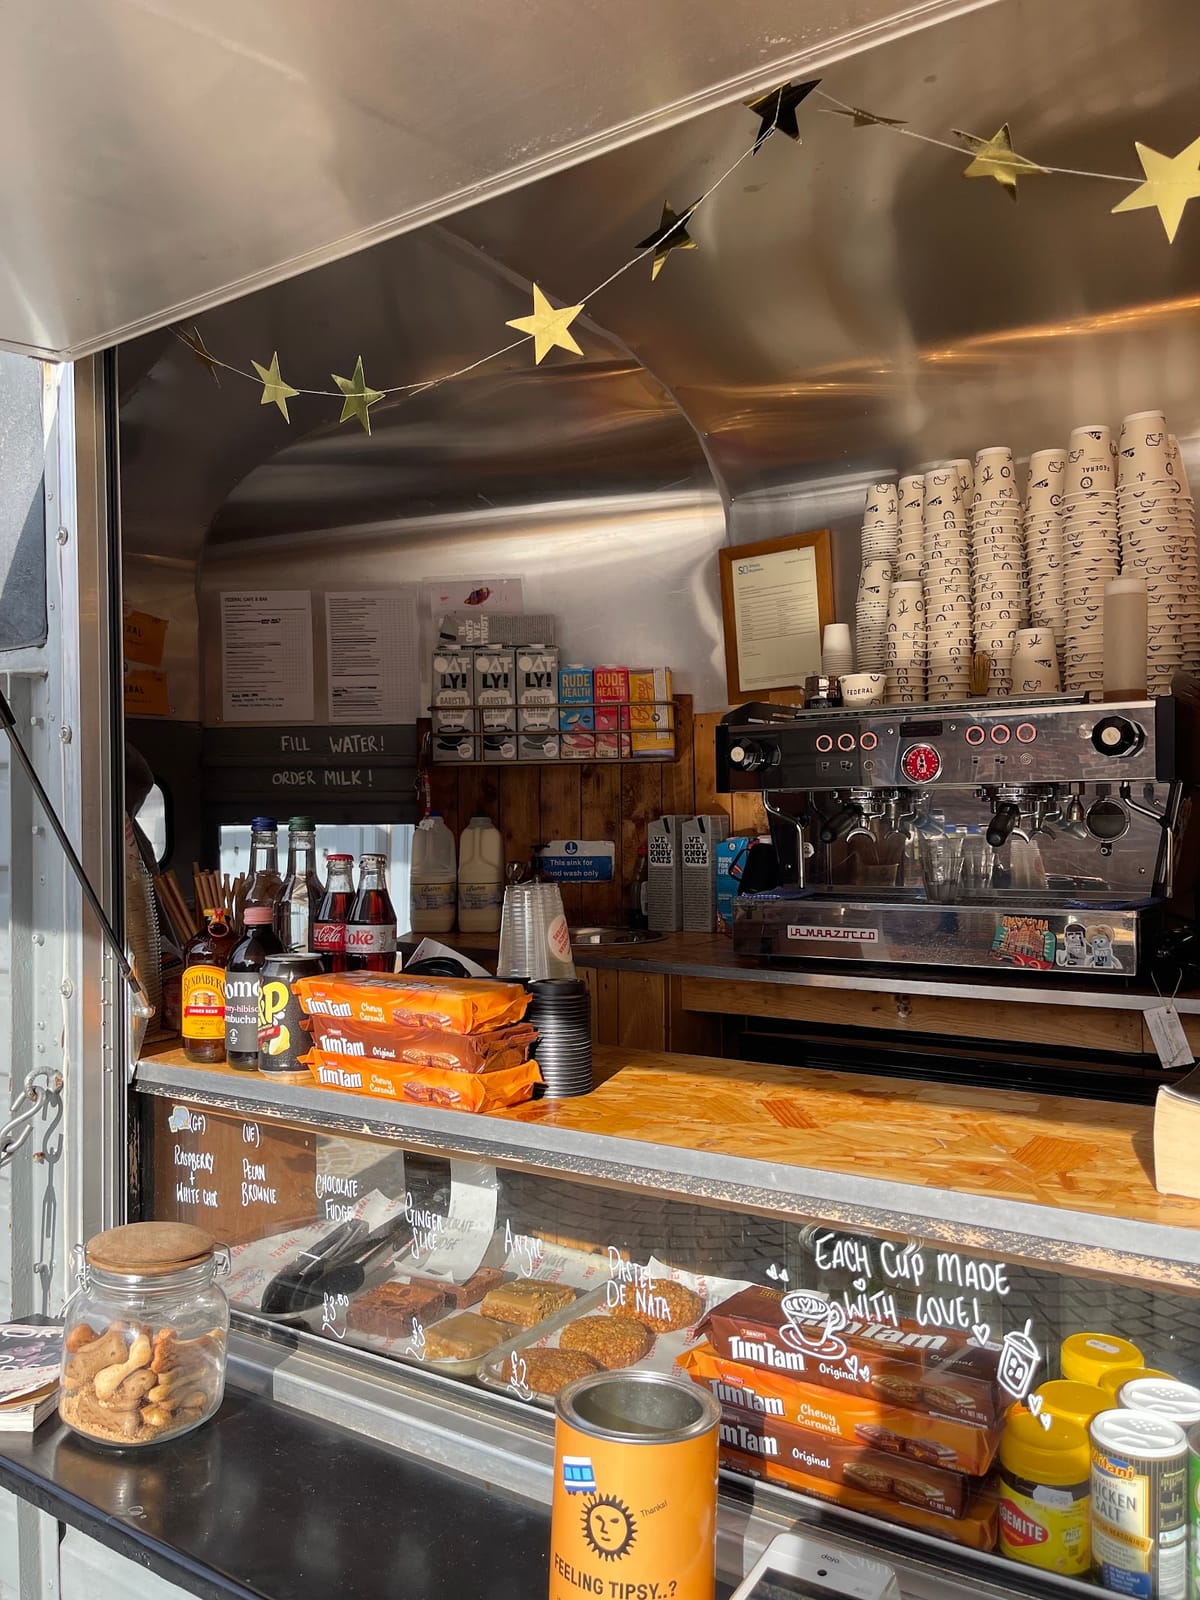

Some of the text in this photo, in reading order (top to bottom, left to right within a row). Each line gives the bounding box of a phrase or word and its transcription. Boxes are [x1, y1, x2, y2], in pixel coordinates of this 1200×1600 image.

[1081, 463, 1110, 474] FEDERAL
[458, 626, 466, 636] IN
[465, 620, 473, 643] OATS
[473, 622, 481, 640] WE
[480, 614, 489, 645] TRUST
[440, 673, 467, 689] LY!
[482, 673, 509, 689] LY!
[525, 672, 552, 688] LY!
[562, 674, 591, 687] RUDE
[596, 672, 626, 687] RUDE
[561, 687, 591, 697] HEALTH
[596, 687, 627, 697] HEALTH
[846, 687, 874, 697] FEDERAL
[280, 734, 385, 753] FILL WATER!
[272, 769, 317, 786] ORDER
[550, 859, 593, 867] This sink for
[583, 870, 599, 879] only
[359, 1012, 387, 1023] Caramel
[361, 1002, 383, 1016] Chewy
[372, 1046, 396, 1059] Original
[369, 1083, 396, 1096] Caramel
[371, 1074, 394, 1089] Chewy
[190, 1113, 206, 1135] (GF)
[243, 1123, 260, 1148] (VE)
[174, 1145, 214, 1174] RASPBERRY
[243, 1158, 266, 1181] PECAN
[176, 1182, 200, 1204] WHITE
[241, 1182, 277, 1207] BROWNIE
[315, 1174, 358, 1199] CHOCOLATE
[325, 1199, 354, 1222] FUDGE
[405, 1191, 445, 1234] GINGER
[411, 1227, 438, 1260] SLICE
[815, 1232, 872, 1279] EACH
[607, 1246, 658, 1291] PASTEL
[606, 1280, 673, 1323] DE NATA
[844, 1289, 980, 1327] WITH LOVE!
[728, 1336, 860, 1381] TimTam Original
[797, 1414, 842, 1435] Caramel
[800, 1403, 836, 1426] Chewy
[792, 1447, 831, 1469] Original
[640, 1499, 668, 1518] Thanks!
[1095, 1495, 1120, 1522] SALT
[554, 1552, 604, 1595] FEELING
